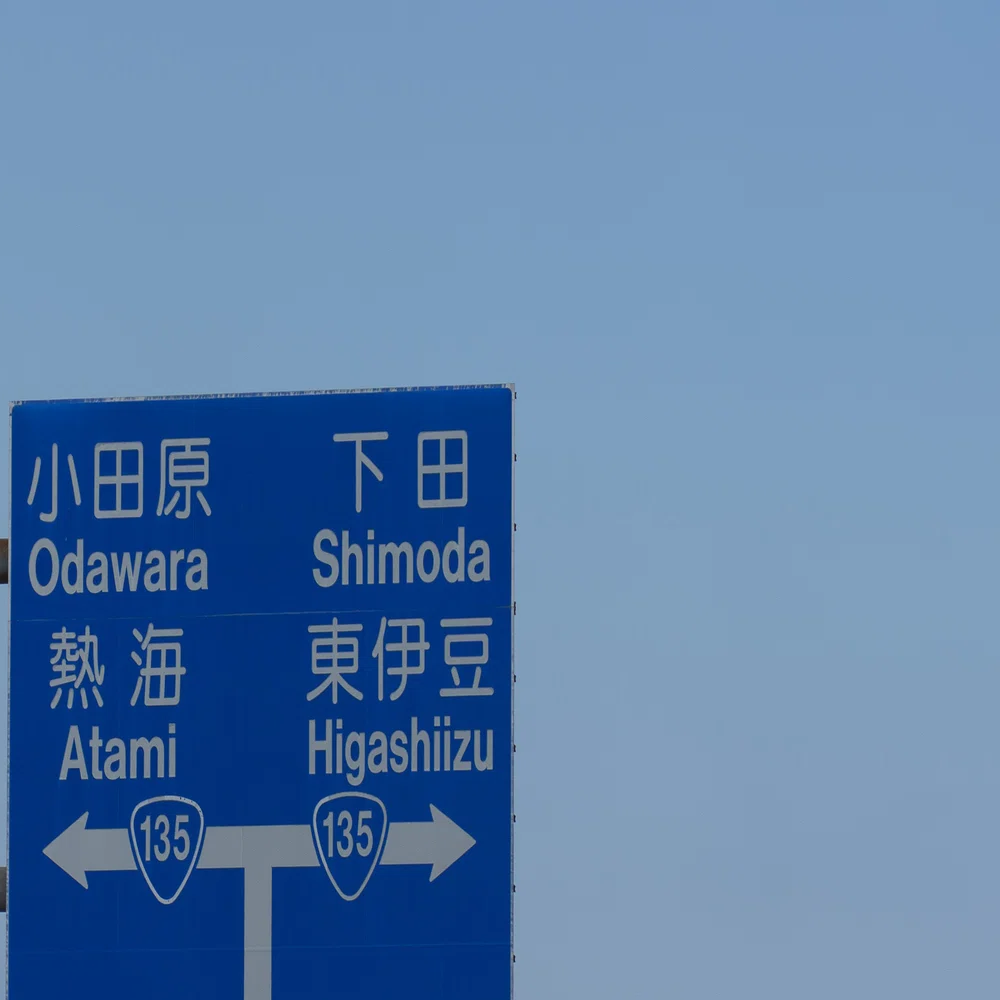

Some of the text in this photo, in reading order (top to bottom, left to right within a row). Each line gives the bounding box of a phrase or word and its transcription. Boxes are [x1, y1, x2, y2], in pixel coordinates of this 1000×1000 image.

[26, 437, 212, 523] 小田原
[332, 429, 469, 513] 下田
[27, 537, 209, 597] Odawara
[311, 526, 492, 588] Shimoda
[49, 622, 187, 710] 熱海
[306, 616, 495, 705] 東伊豆
[58, 722, 177, 781] Atami
[307, 715, 494, 787] Higashiizu
[139, 814, 191, 862] 135
[322, 809, 374, 858] 135
